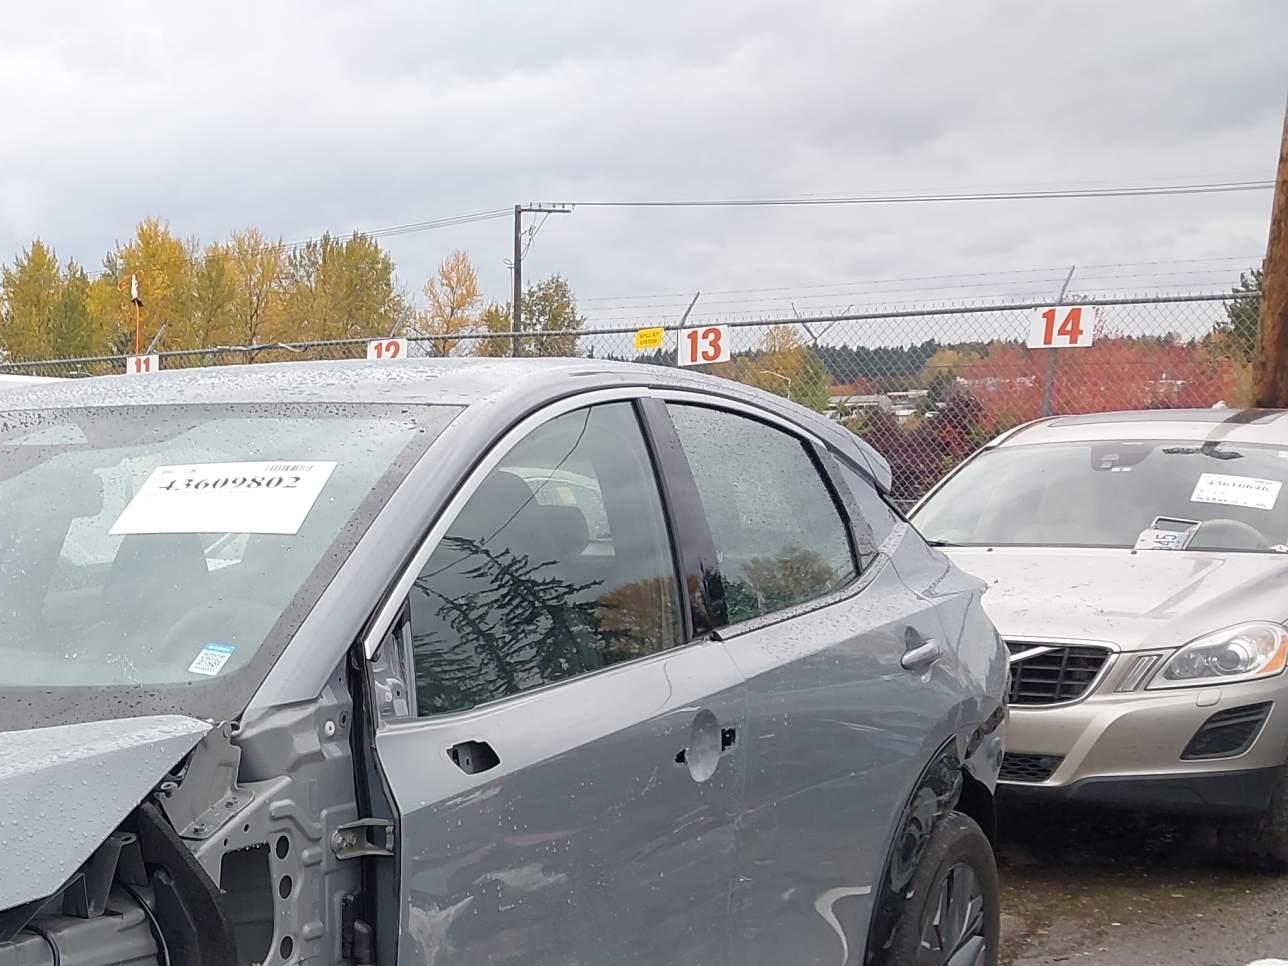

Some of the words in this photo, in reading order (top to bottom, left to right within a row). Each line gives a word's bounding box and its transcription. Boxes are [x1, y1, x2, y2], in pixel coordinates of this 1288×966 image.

[1042, 308, 1083, 345] 14
[687, 328, 722, 362] 13
[135, 357, 150, 373] 11
[159, 476, 302, 491] 43609802
